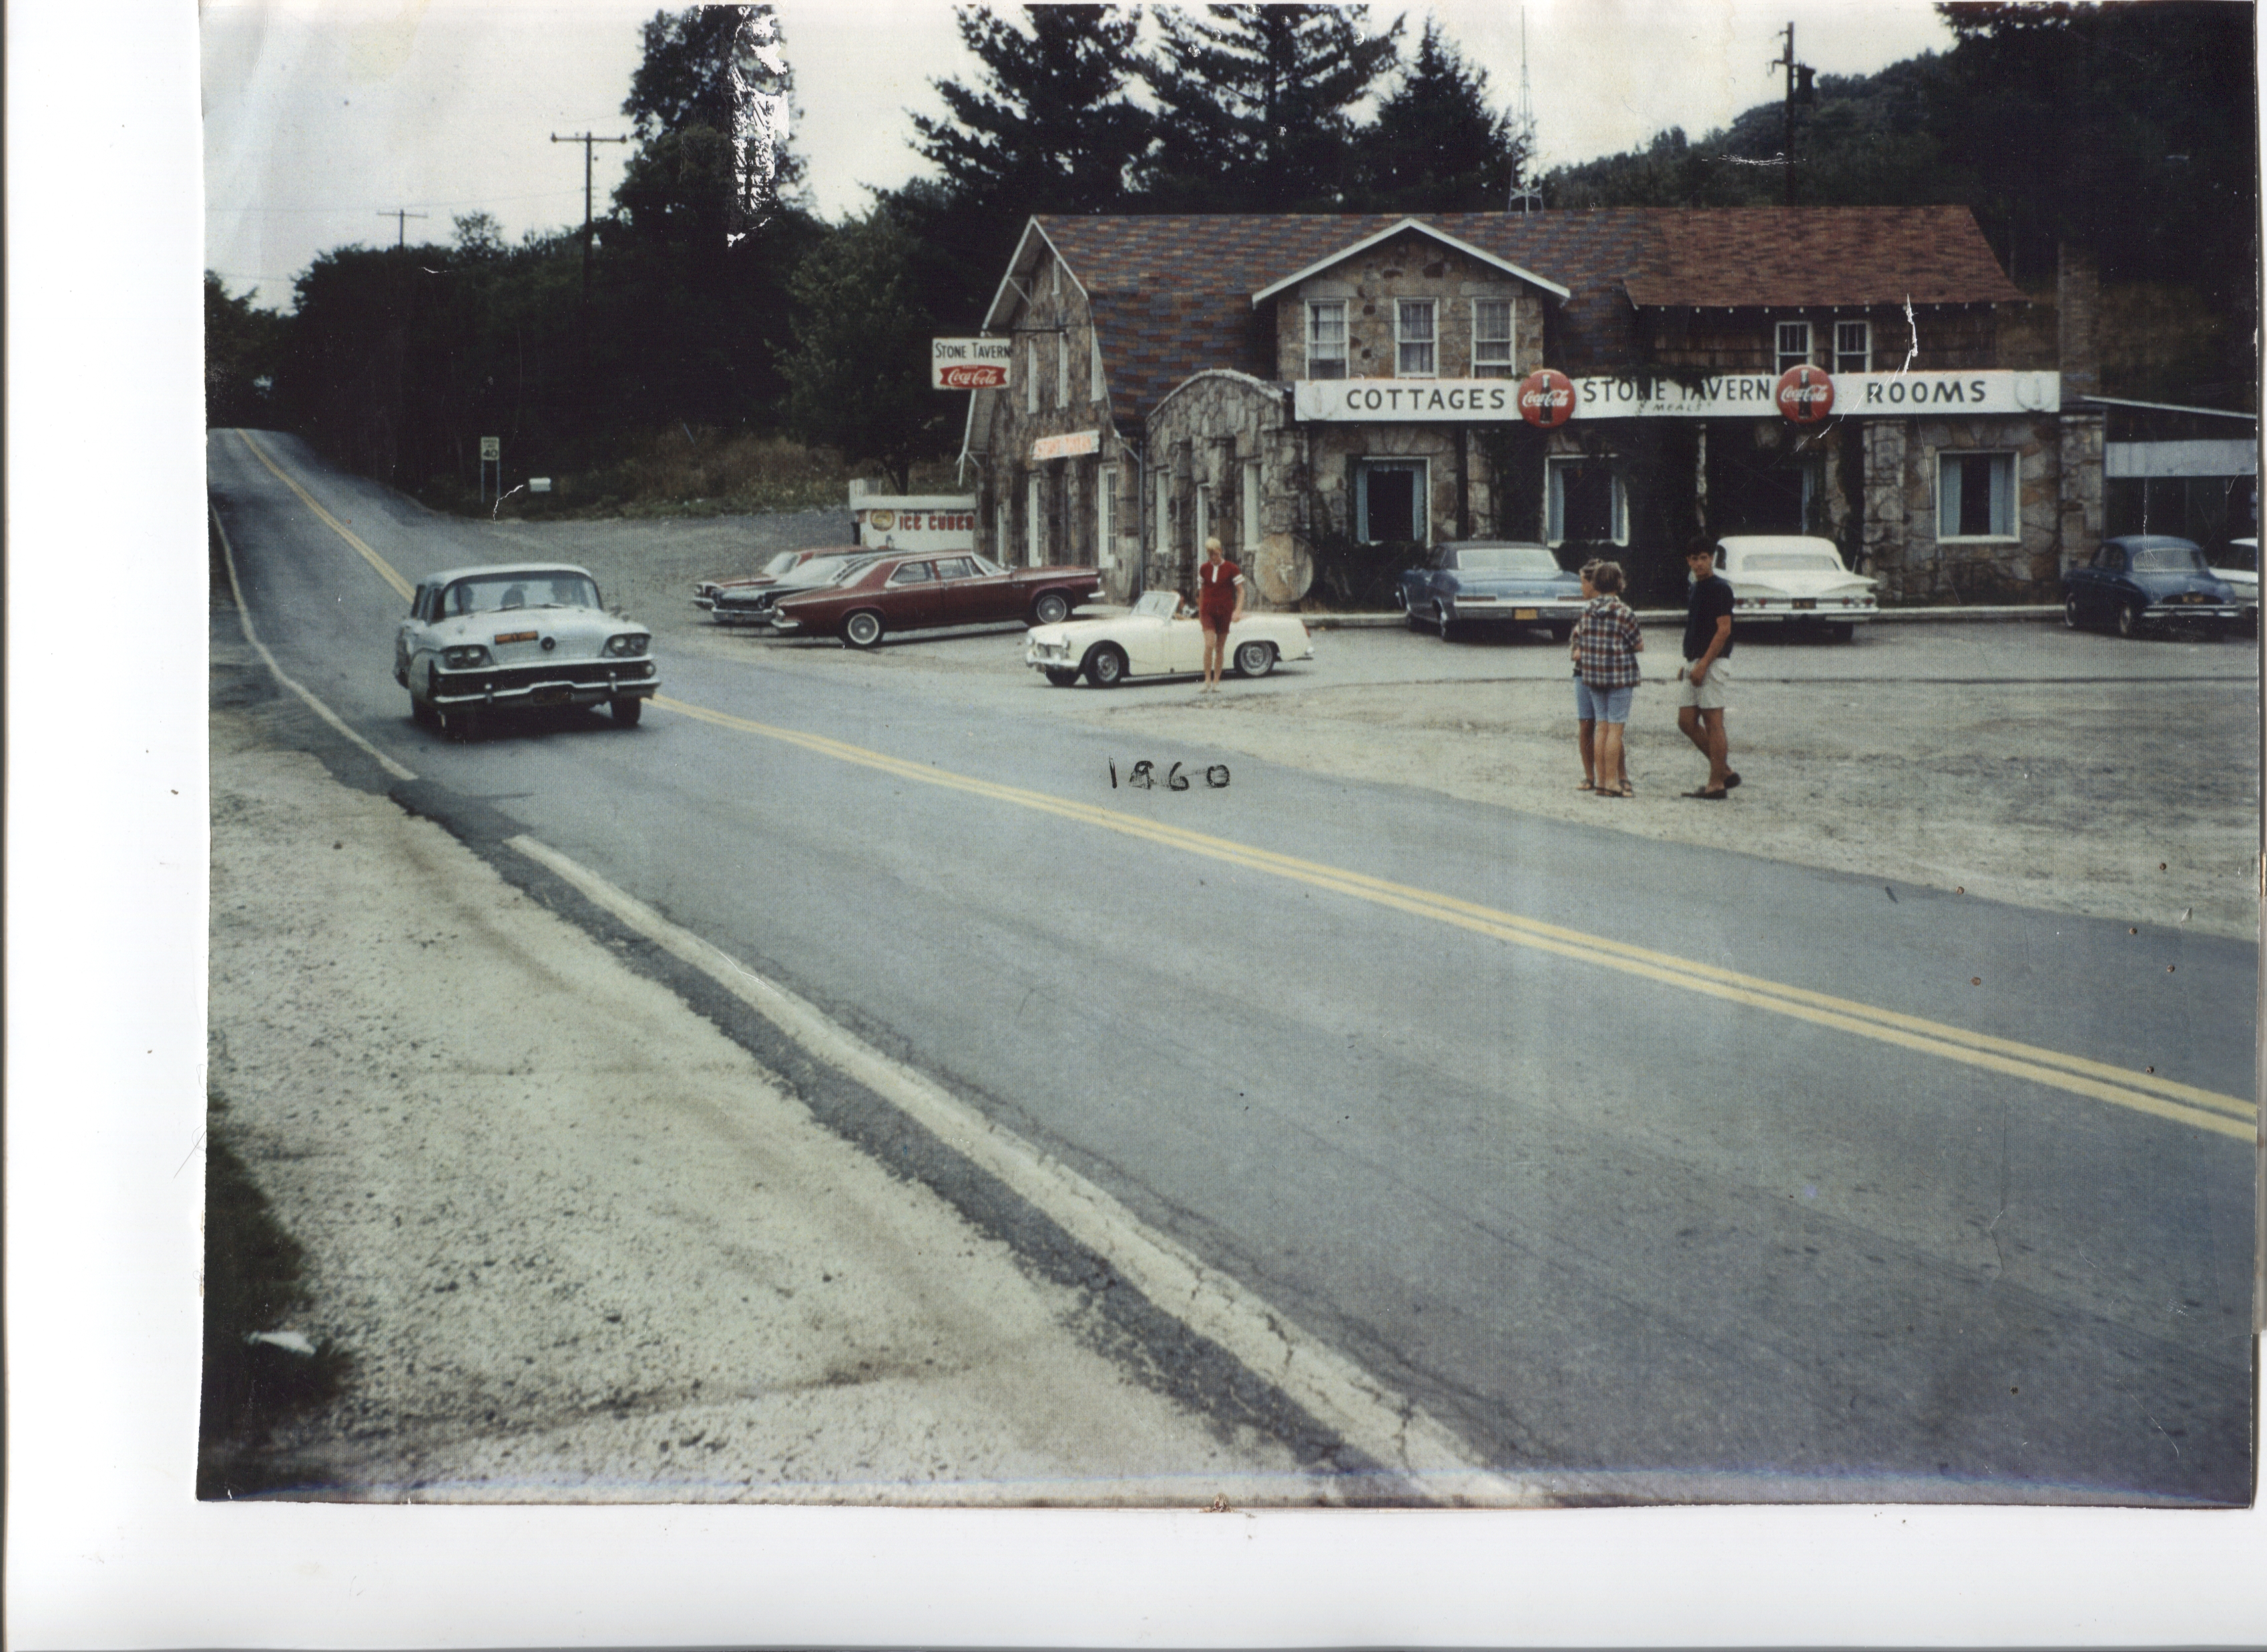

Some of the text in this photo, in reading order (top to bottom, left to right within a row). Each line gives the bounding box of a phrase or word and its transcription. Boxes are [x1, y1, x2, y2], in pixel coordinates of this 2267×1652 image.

[935, 342, 1011, 358] STONE TAVERN
[1346, 389, 1505, 410] COTTAGES
[1867, 380, 1986, 403] ROOMS
[900, 515, 922, 531] ICE
[929, 515, 975, 531] CUBES
[1109, 756, 1230, 791] 1960
